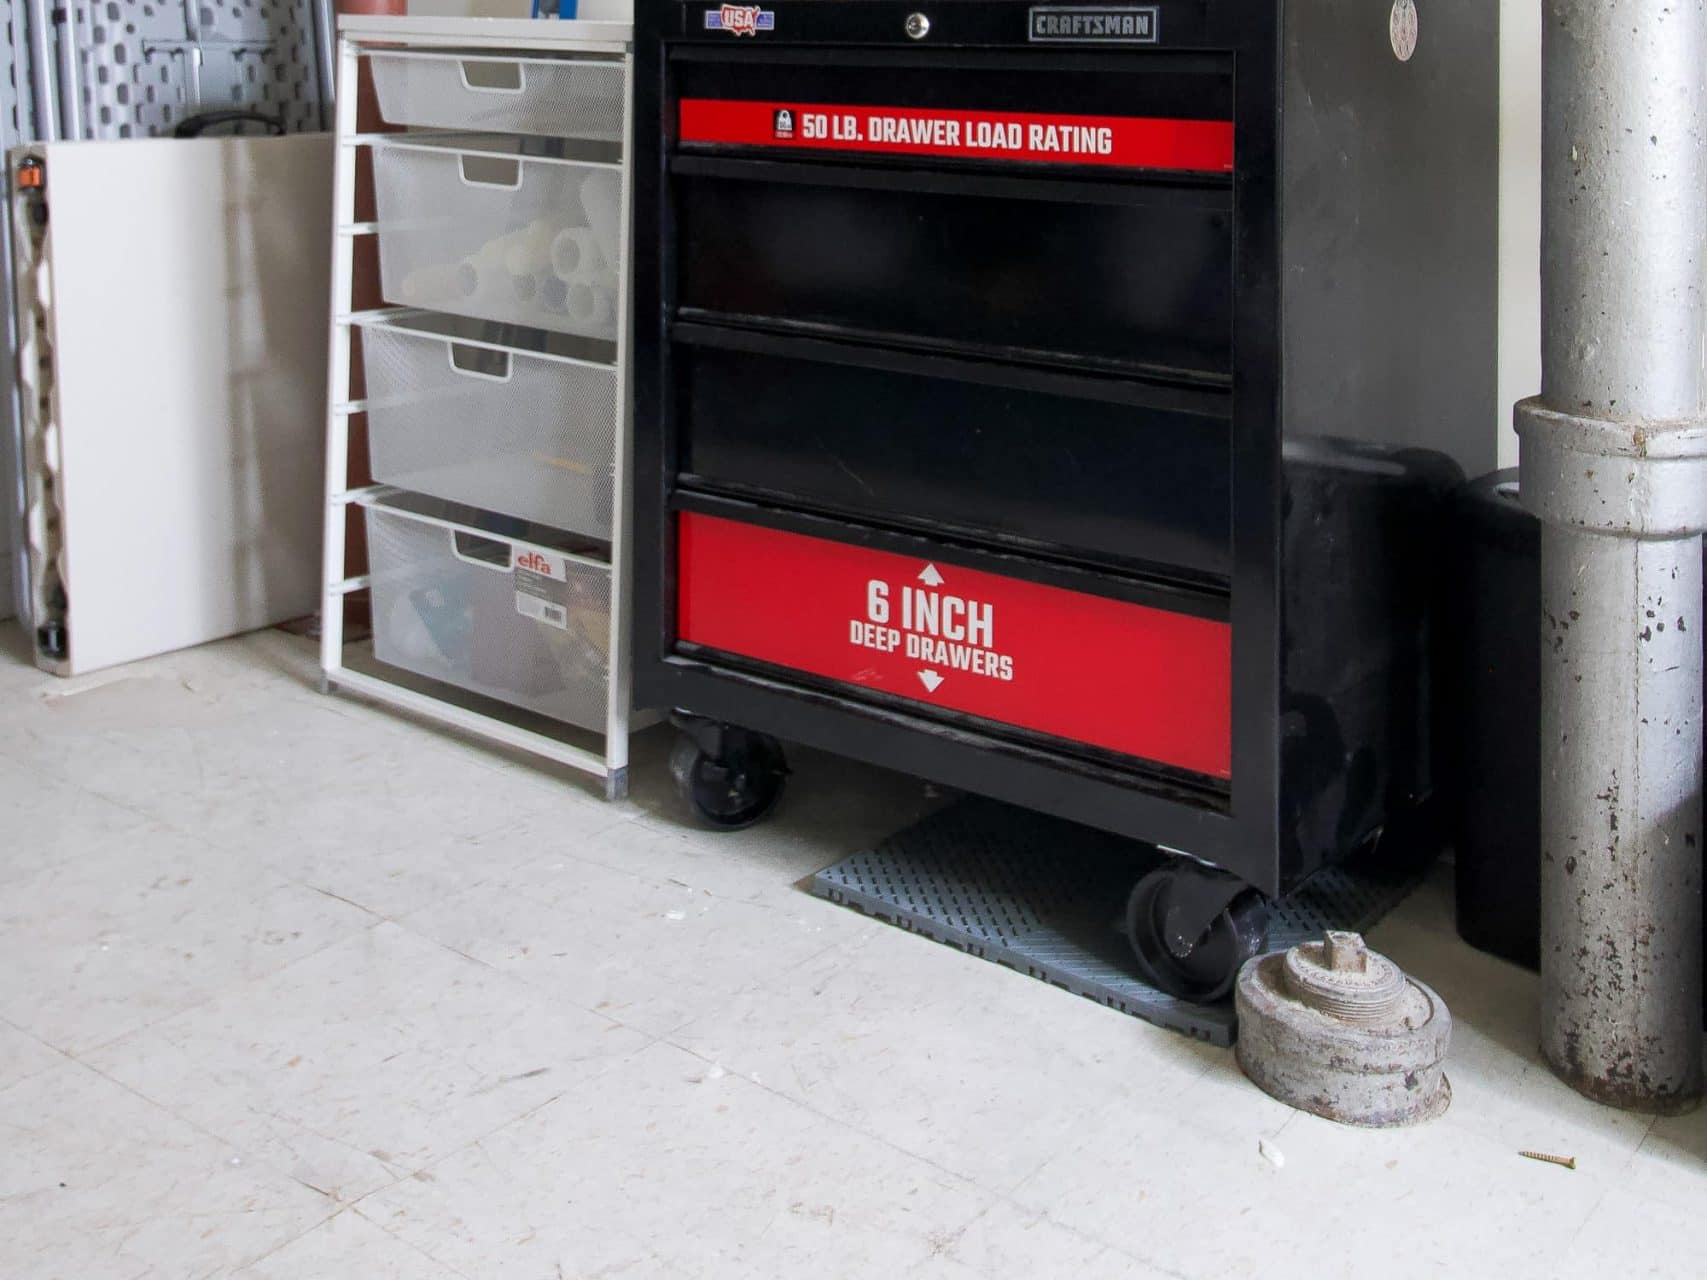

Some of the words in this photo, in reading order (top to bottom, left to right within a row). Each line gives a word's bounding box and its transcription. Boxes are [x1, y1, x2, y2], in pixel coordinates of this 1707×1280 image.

[723, 9, 754, 28] USA
[1036, 14, 1149, 35] CRAFTSMAN
[802, 113, 828, 139] 50
[832, 115, 864, 141] LB.
[868, 116, 961, 147] DRAWER
[965, 121, 1023, 150] LOAD
[1028, 123, 1113, 155] RATING
[517, 551, 552, 575] elfa
[867, 579, 890, 624] 6
[902, 585, 993, 649] INCH
[850, 619, 901, 653] DEEP
[905, 633, 1014, 682] DRAWERS
